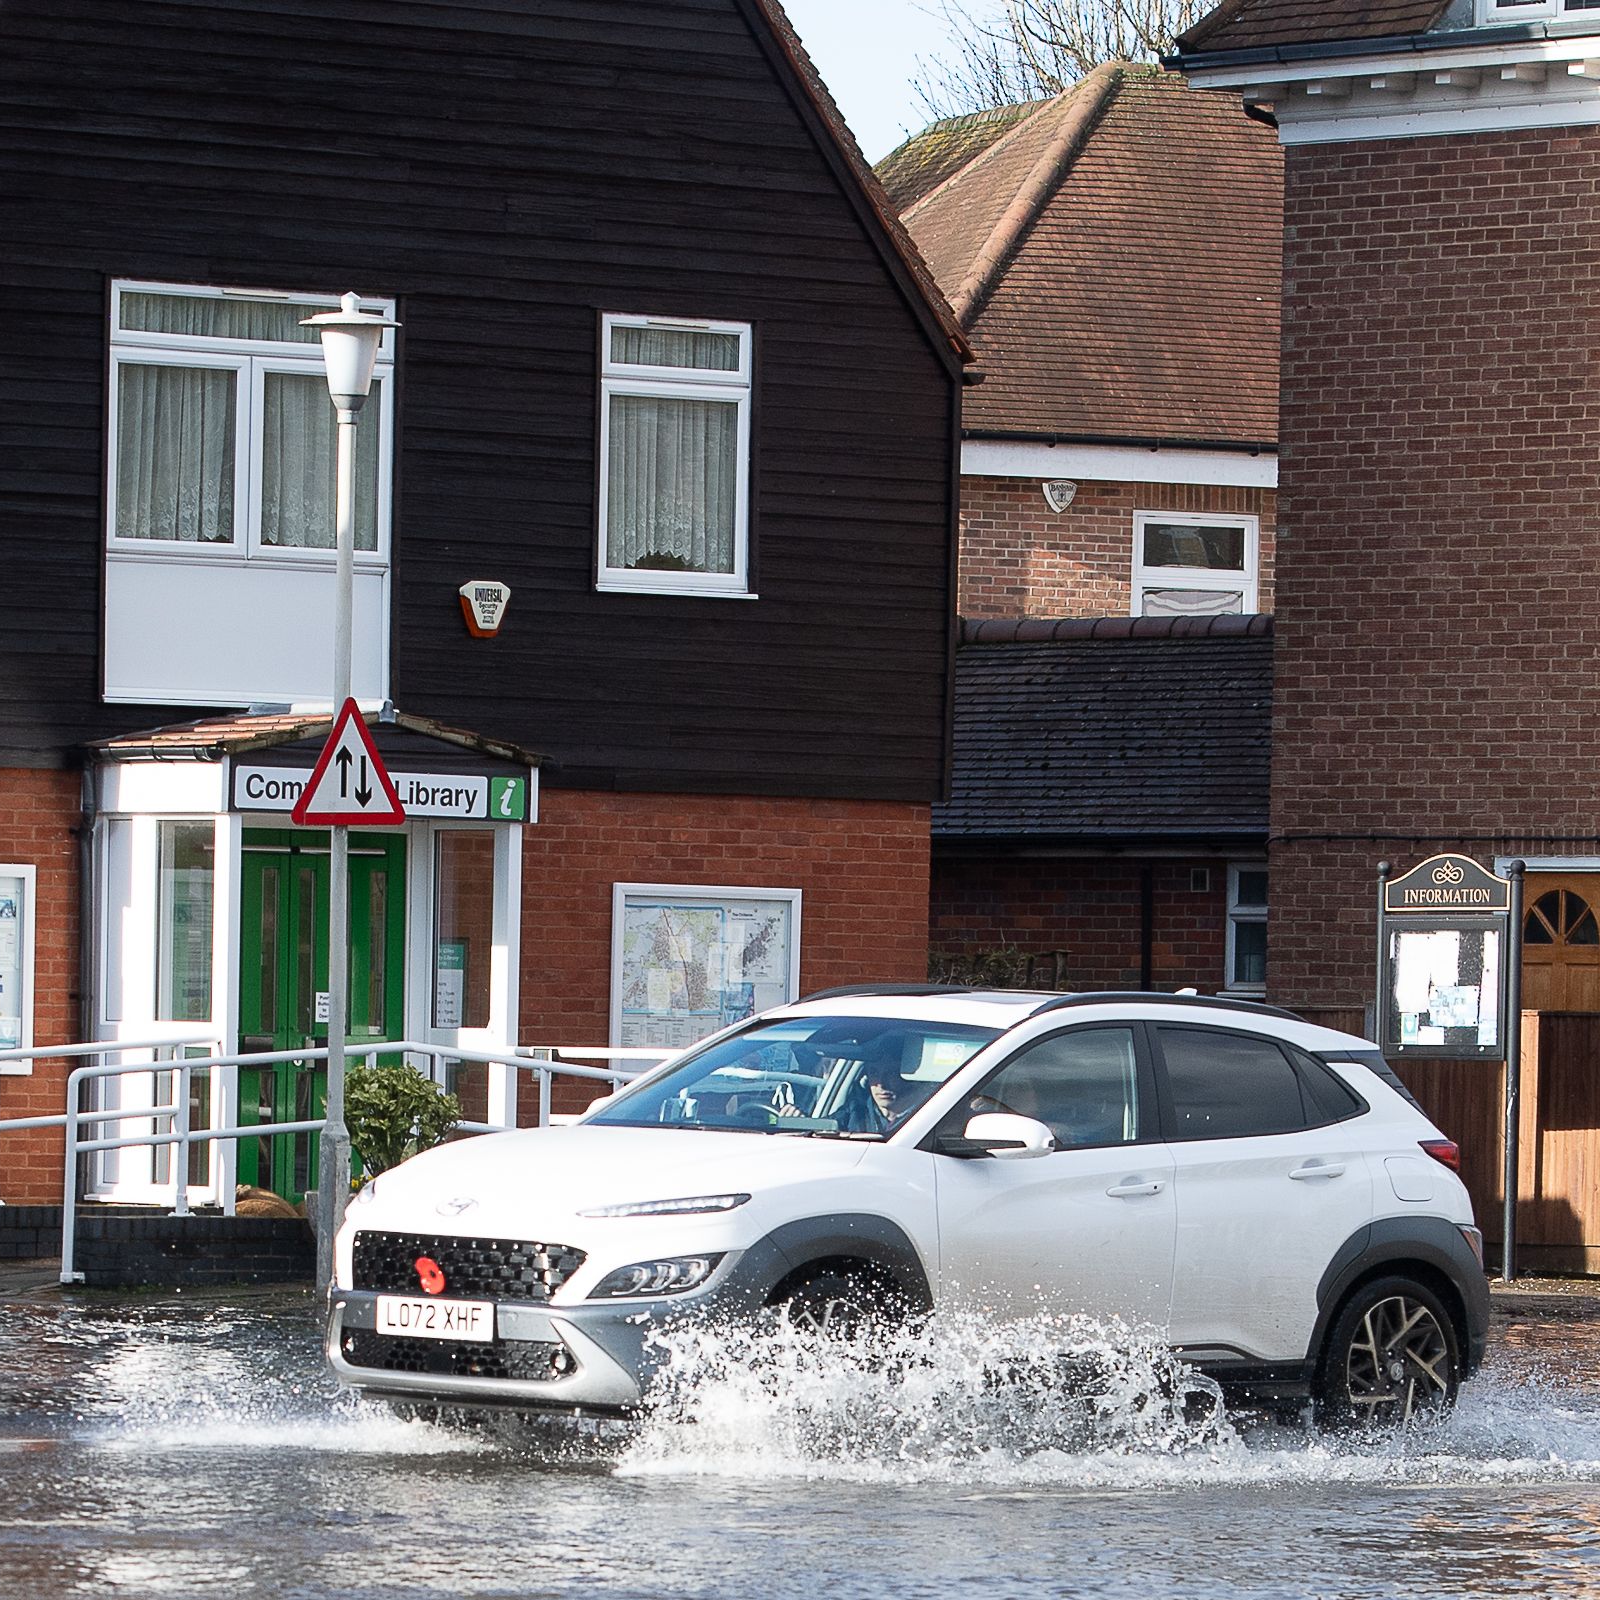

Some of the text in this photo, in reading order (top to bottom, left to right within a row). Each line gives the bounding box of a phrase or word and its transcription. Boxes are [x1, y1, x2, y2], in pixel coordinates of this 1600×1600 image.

[475, 587, 503, 603] UNIVERSAL
[479, 602, 498, 610] Security
[395, 783, 478, 814] Library
[1404, 888, 1491, 904] INFORMATION
[387, 1302, 482, 1332] LO72 XHF
